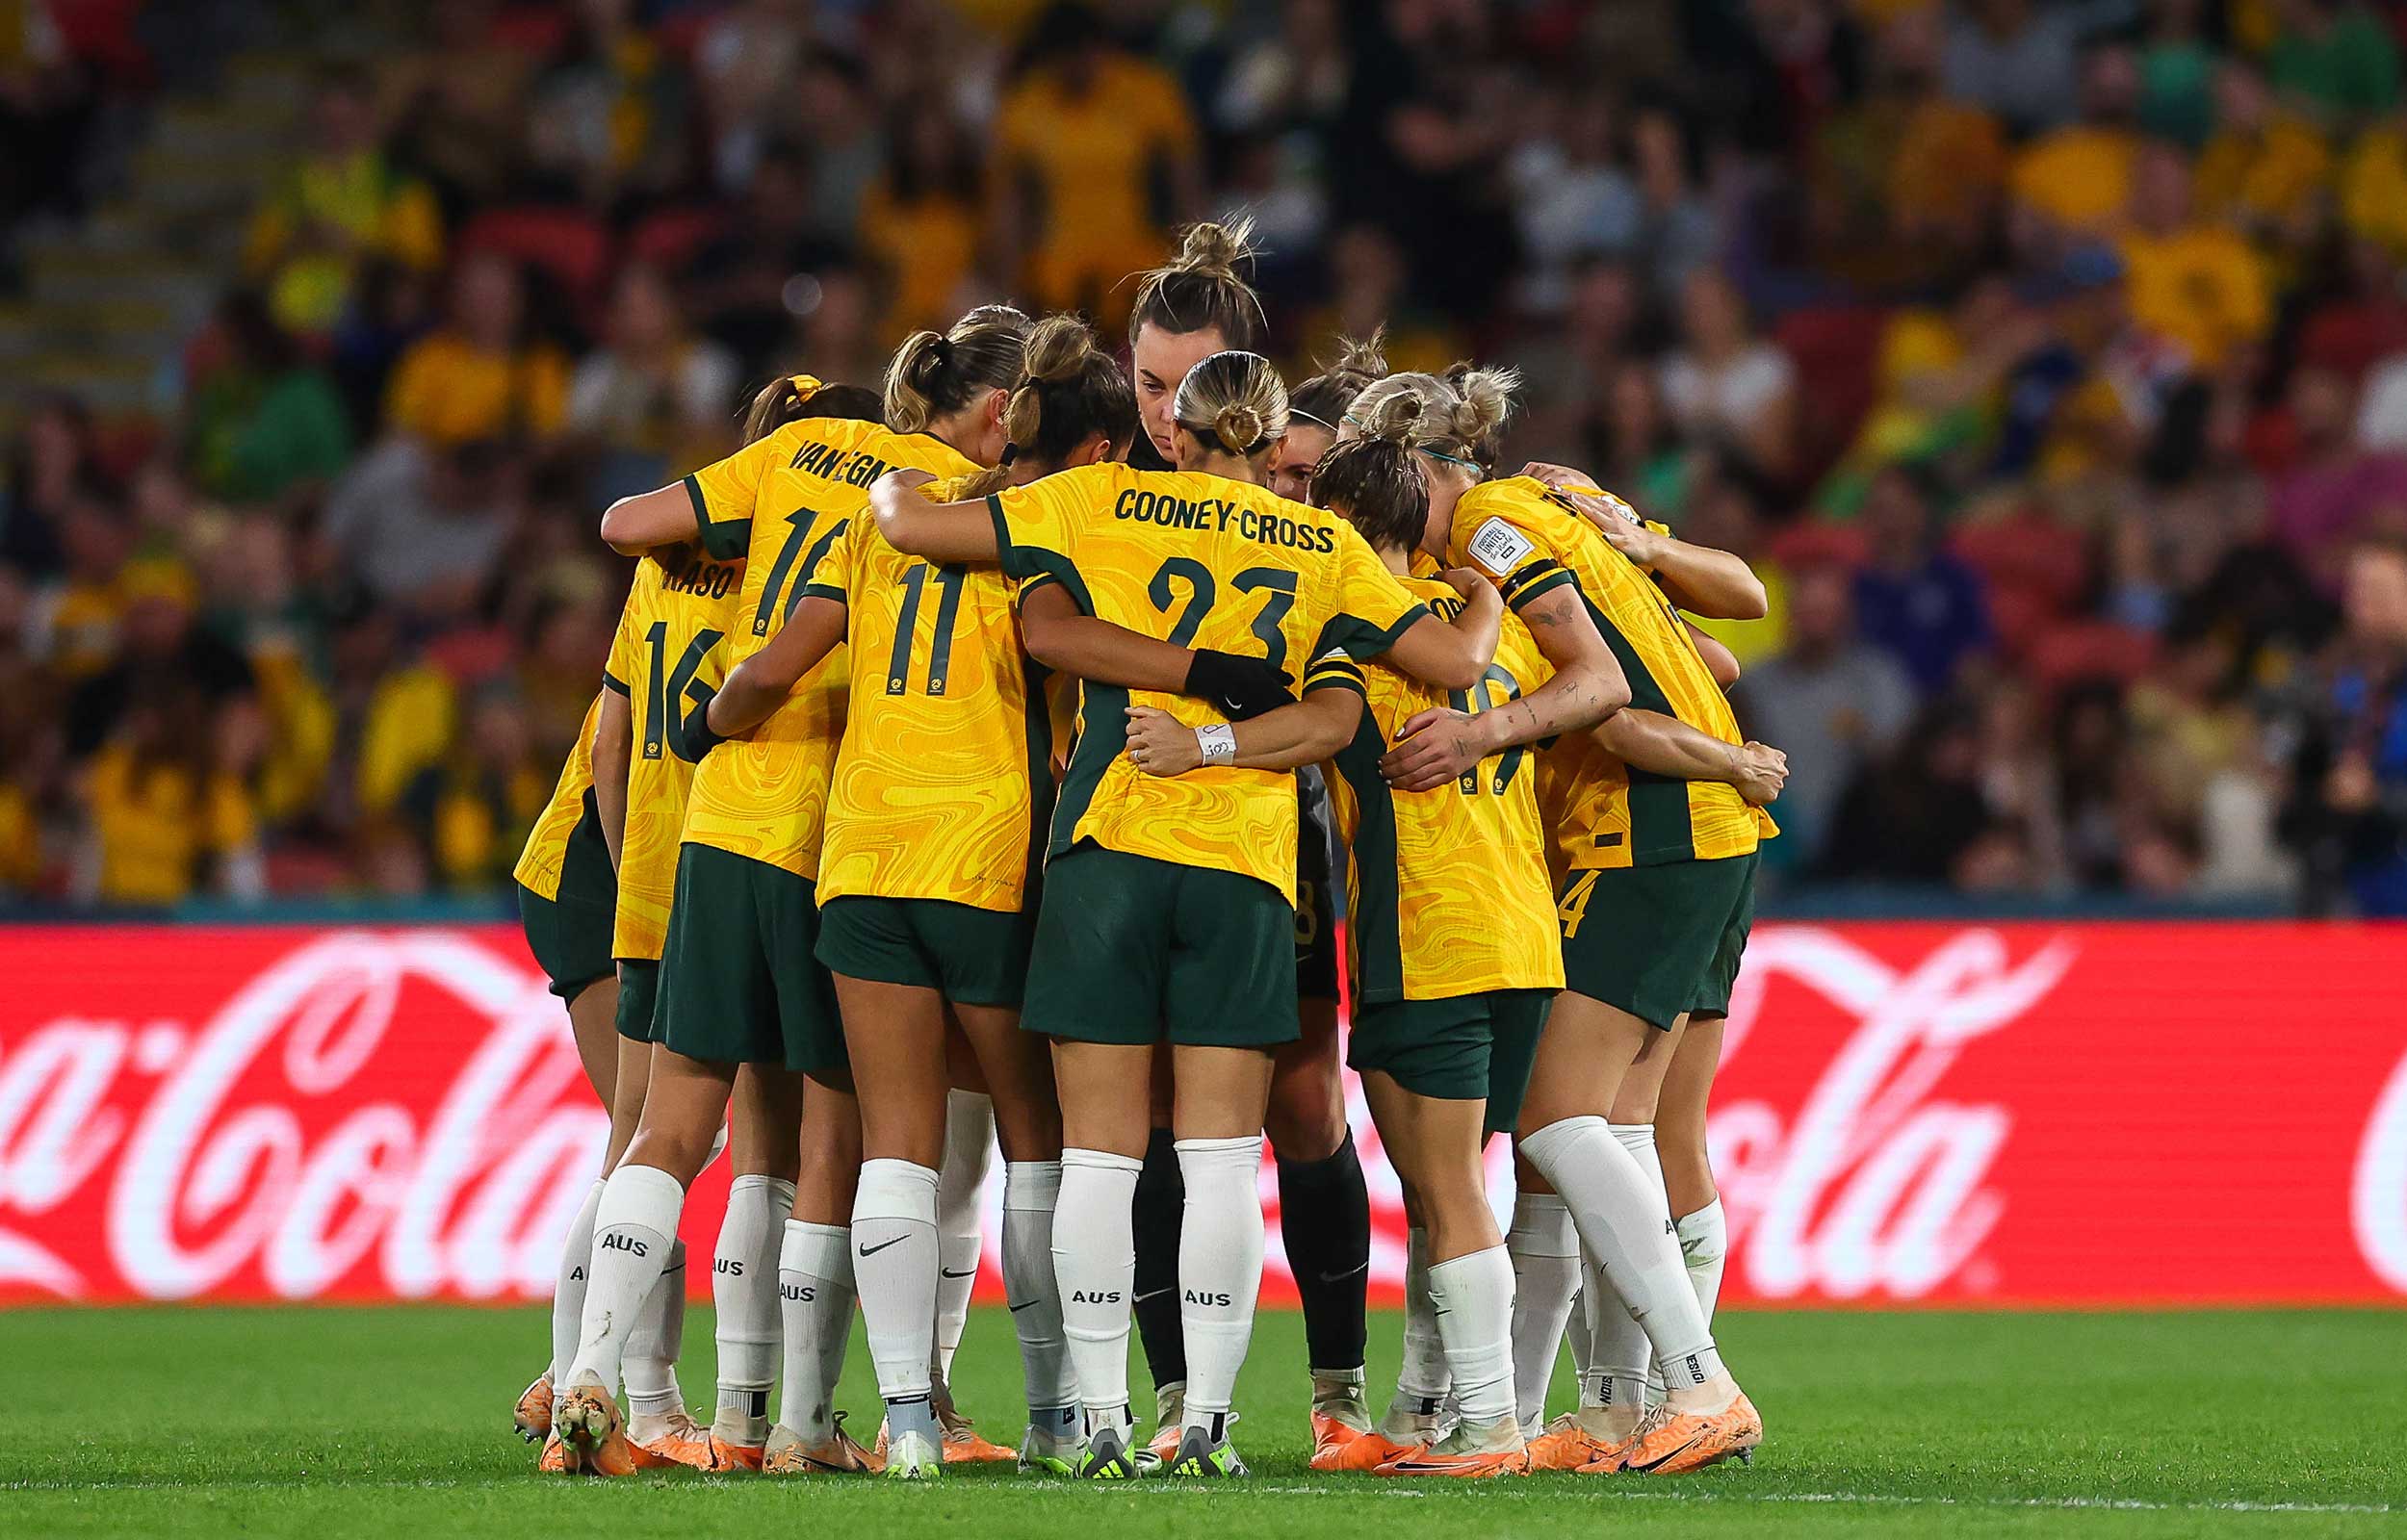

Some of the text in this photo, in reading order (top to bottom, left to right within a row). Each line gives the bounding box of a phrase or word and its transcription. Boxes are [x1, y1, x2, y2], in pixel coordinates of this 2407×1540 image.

[789, 439, 848, 480] VAN
[1114, 488, 1334, 553] COONEY-CROSS
[885, 562, 969, 696] 11
[1147, 556, 1299, 674] 23
[642, 621, 726, 765] 16
[601, 1232, 649, 1258] AUS
[780, 1281, 816, 1302] AUS
[1072, 1290, 1121, 1304] AUS
[1185, 1289, 1231, 1307] AUS
